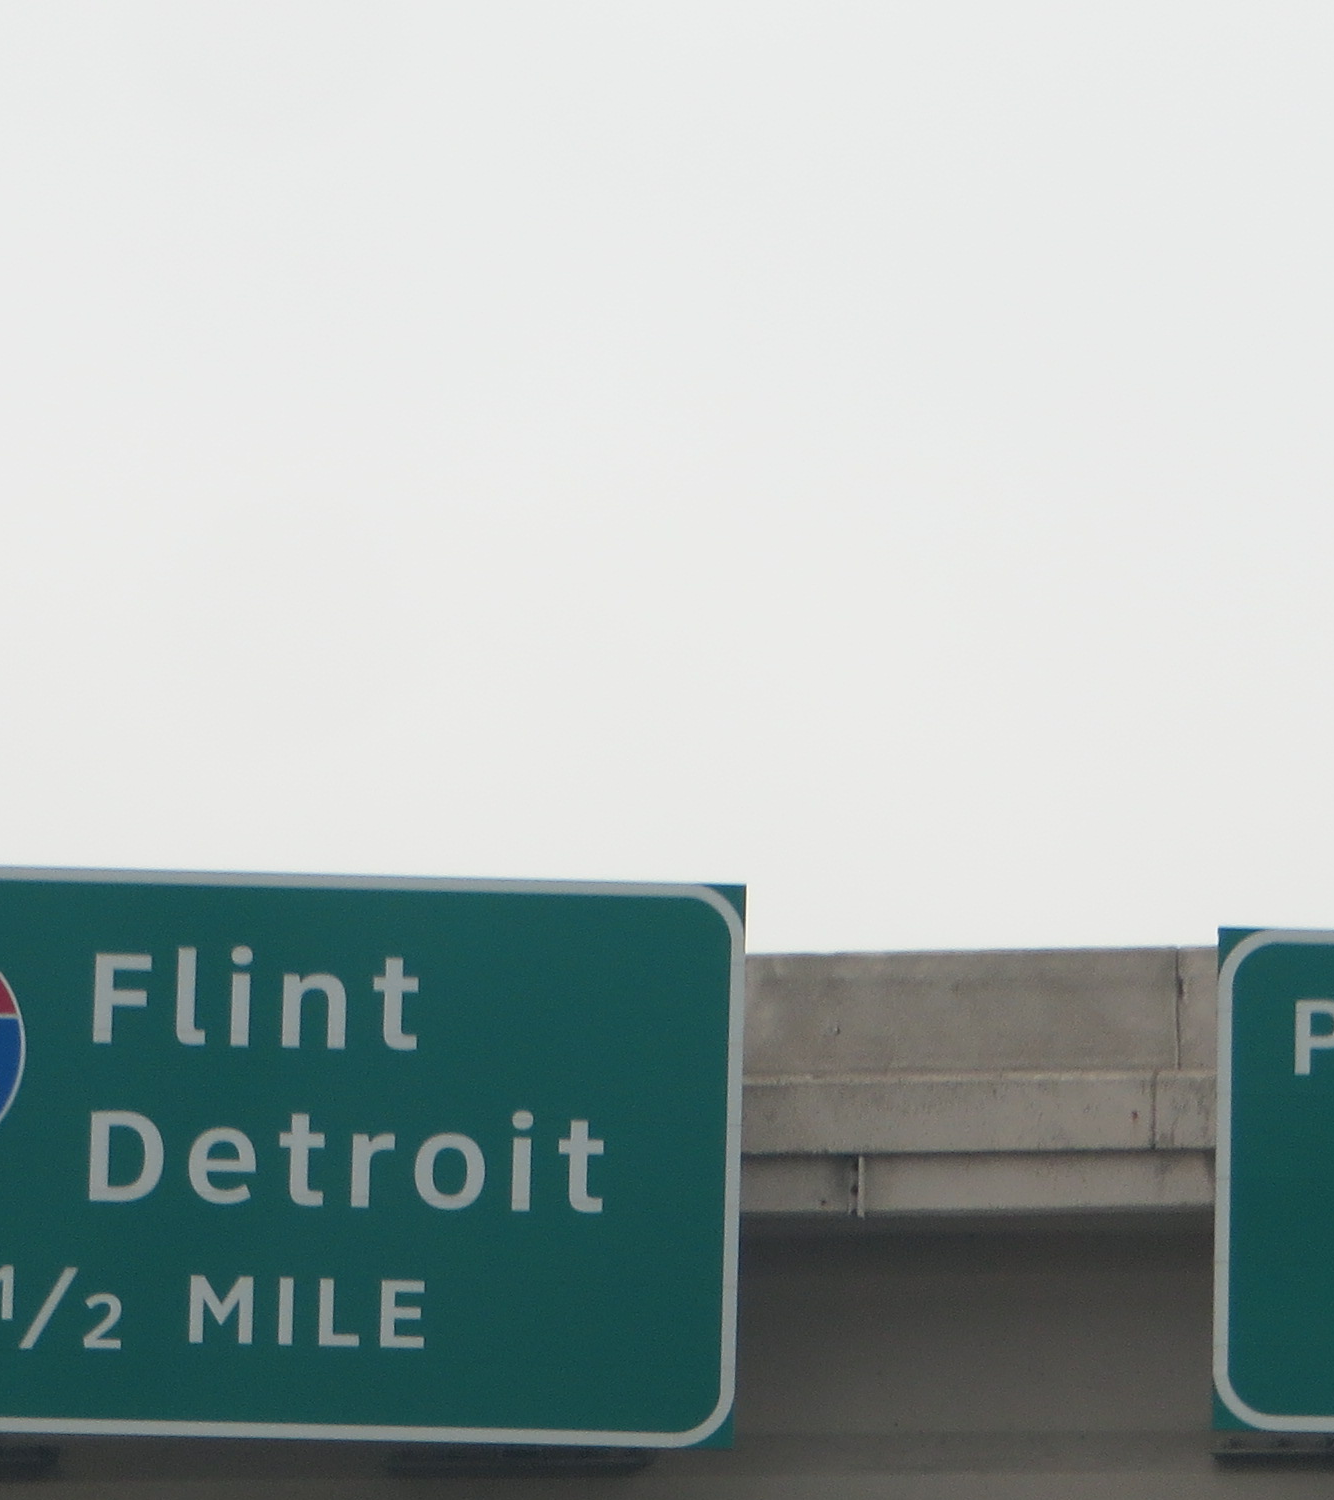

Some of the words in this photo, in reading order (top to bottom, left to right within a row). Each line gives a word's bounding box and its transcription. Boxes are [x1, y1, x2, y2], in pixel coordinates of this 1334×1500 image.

[92, 945, 420, 1051] Flint
[88, 1109, 605, 1213] Detroit
[188, 1274, 427, 1349] MILE
